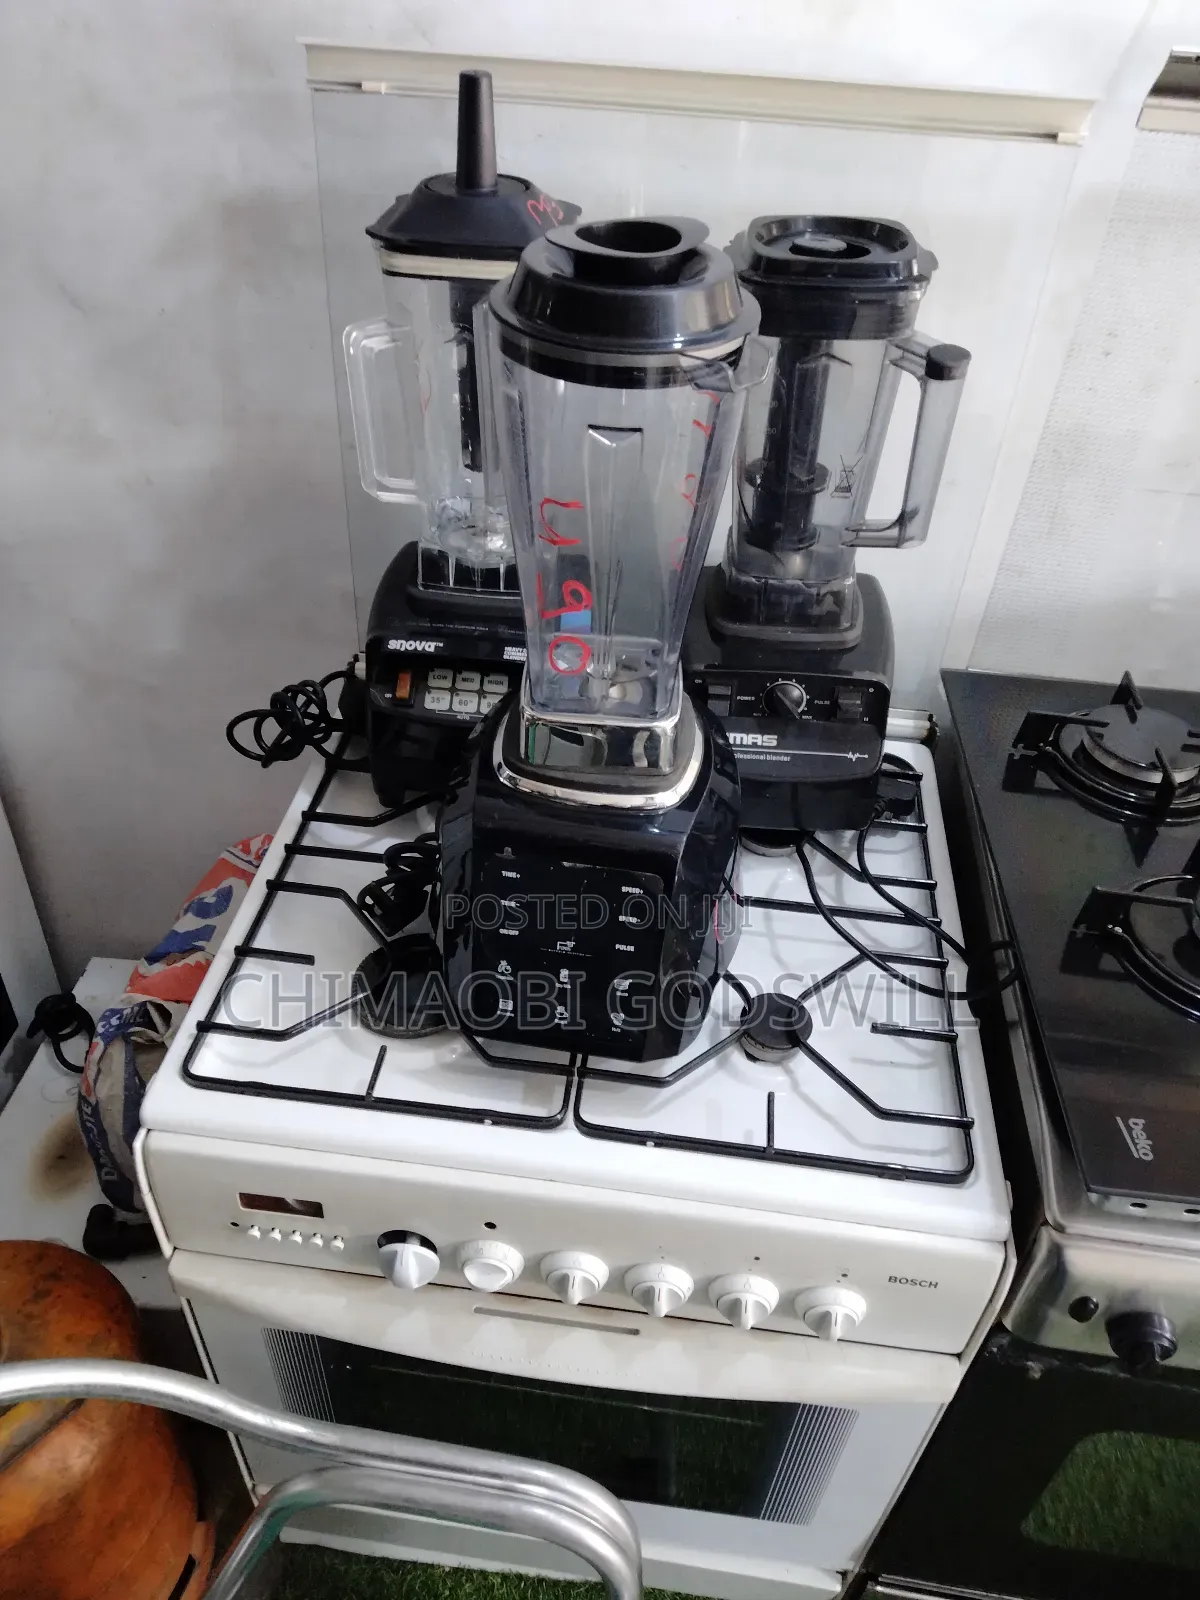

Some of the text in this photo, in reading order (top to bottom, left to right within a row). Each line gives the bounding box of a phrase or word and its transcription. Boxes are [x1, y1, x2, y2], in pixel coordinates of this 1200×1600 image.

[767, 754, 791, 762] blender
[615, 943, 635, 952] PULSE
[1128, 1117, 1154, 1161] beko
[887, 1275, 939, 1289] BOSCH
